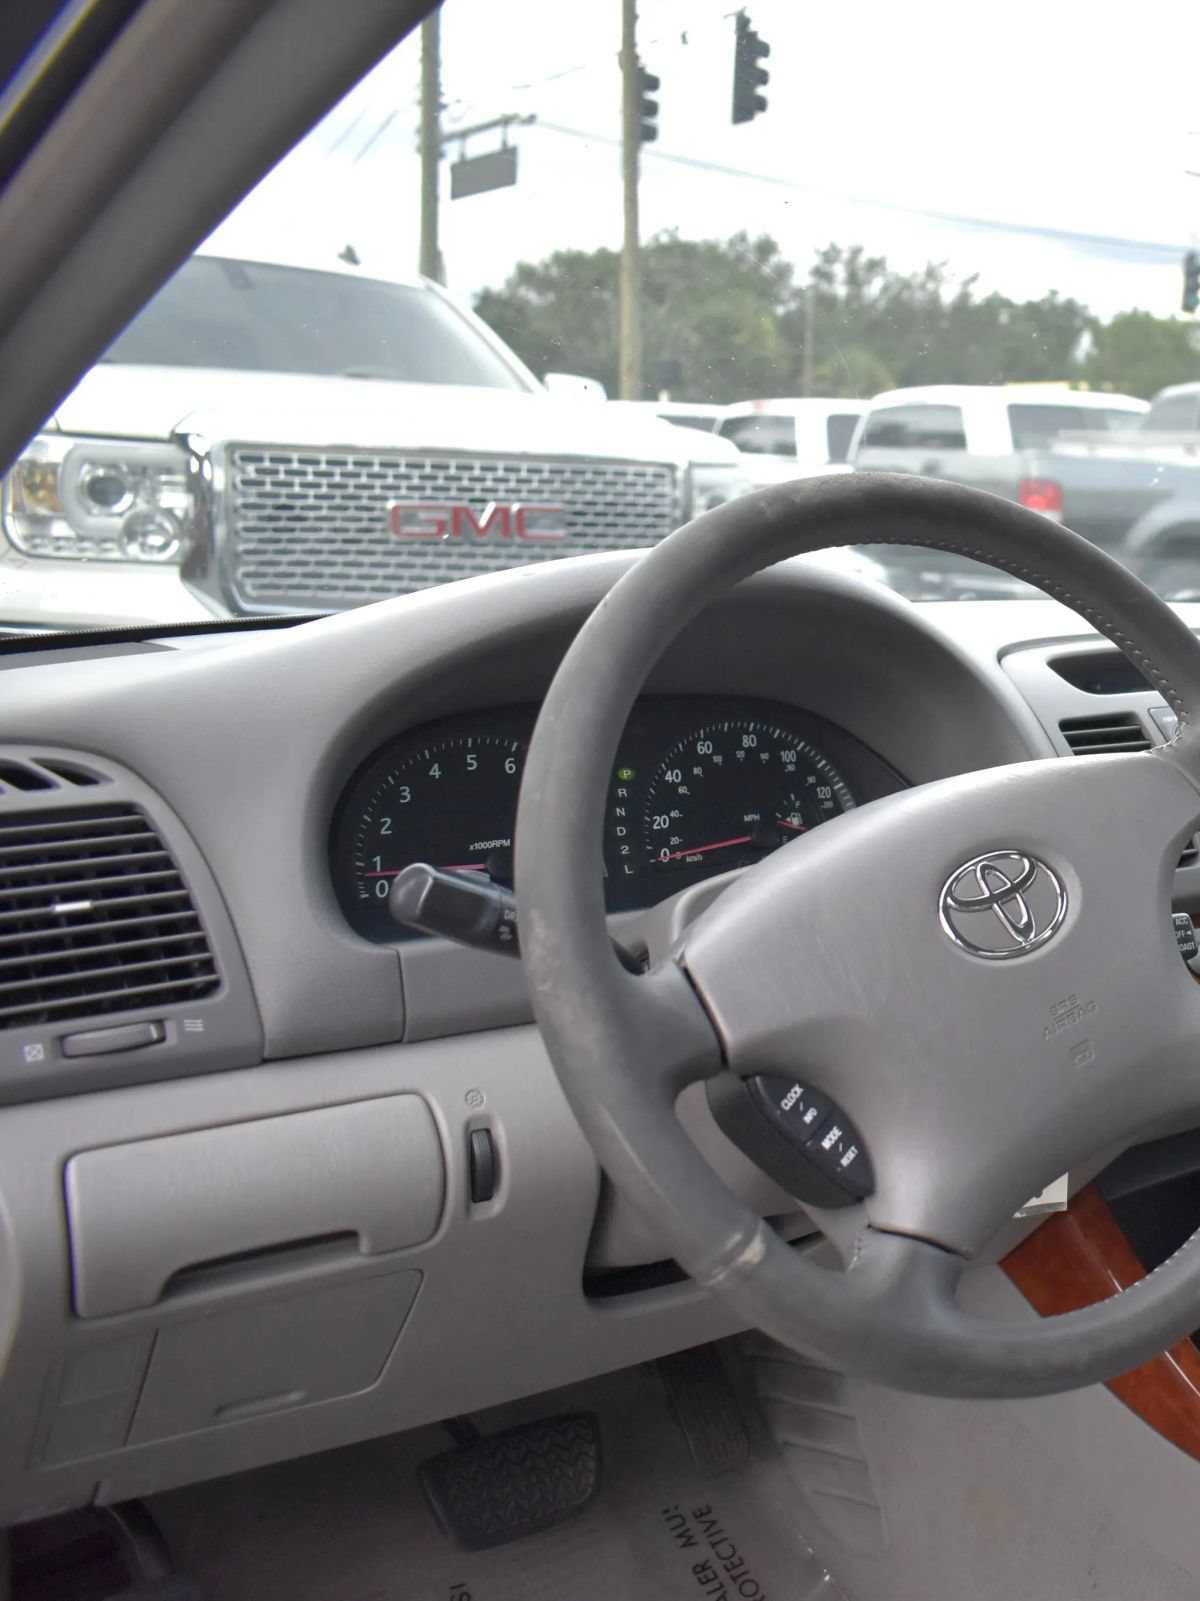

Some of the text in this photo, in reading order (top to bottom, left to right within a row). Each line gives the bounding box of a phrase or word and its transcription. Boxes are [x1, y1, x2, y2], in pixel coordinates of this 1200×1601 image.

[389, 503, 567, 541] GMC
[696, 741, 713, 755] 60
[742, 734, 757, 748] 80
[466, 754, 478, 771] 5
[781, 750, 797, 763] 100
[428, 763, 442, 779] 4
[504, 757, 517, 774] 6
[623, 769, 632, 779] P
[664, 769, 682, 783] 40
[399, 786, 411, 803] 3
[618, 788, 628, 797] R
[816, 786, 832, 799] 120
[616, 807, 626, 817] N
[669, 809, 680, 818] 40
[743, 814, 760, 823] MPH
[380, 817, 392, 835] 2
[652, 815, 670, 829] 20
[616, 826, 626, 836] D
[620, 845, 630, 855] 2
[660, 848, 670, 862] 0
[372, 855, 382, 873] 1
[624, 865, 634, 874] L
[375, 879, 389, 898] 0
[1175, 917, 1189, 925] ACC
[1179, 942, 1195, 951] OAST
[780, 1083, 804, 1111] CLOCK
[821, 1125, 843, 1151] MODE
[662, 1505, 699, 1549] MU
